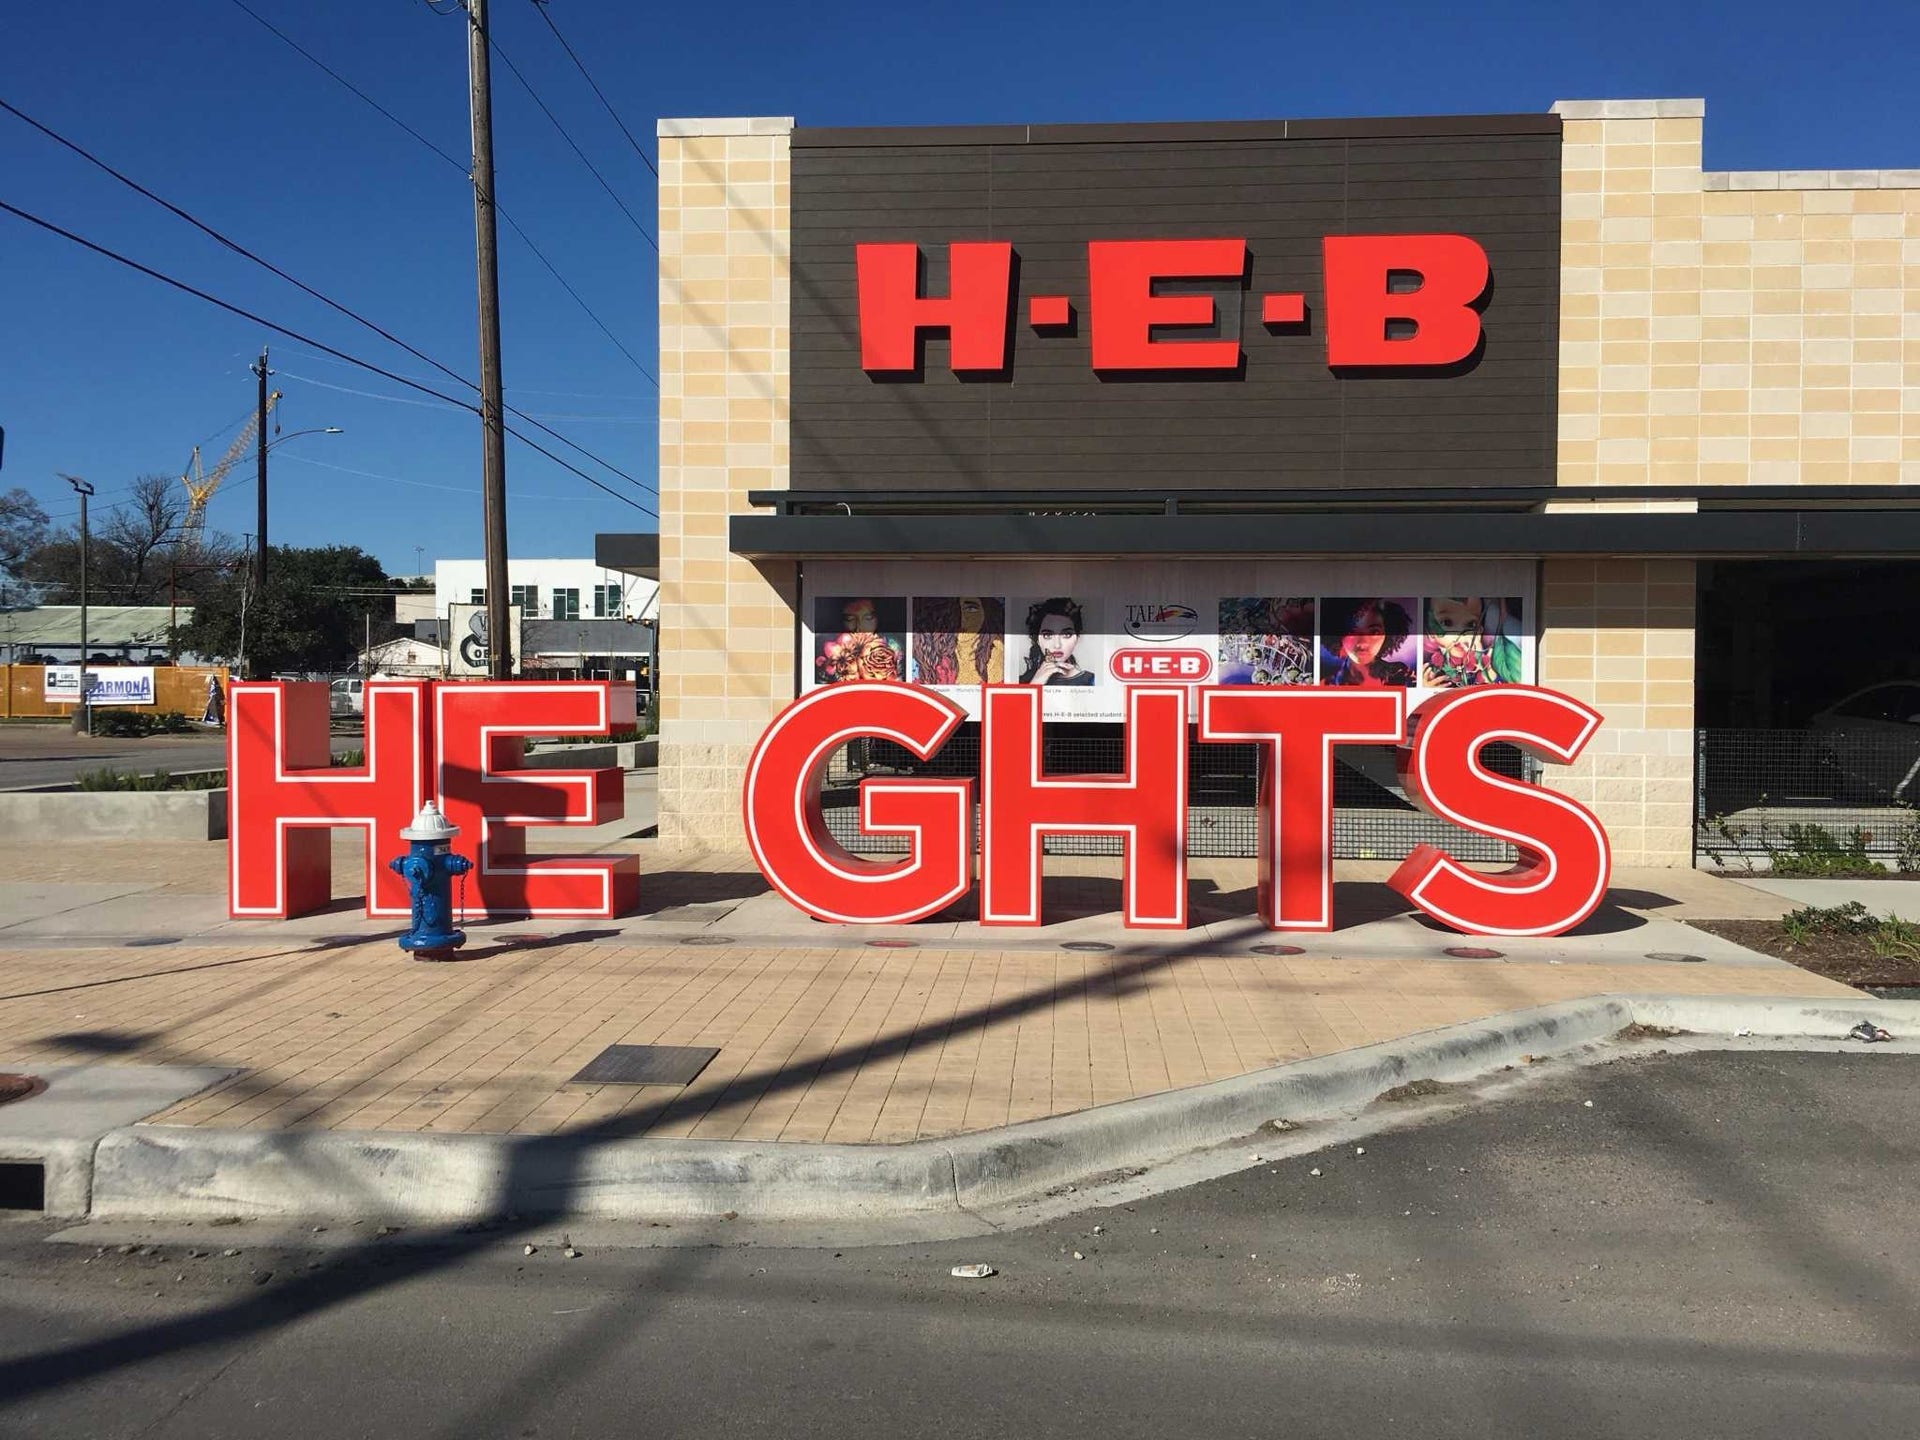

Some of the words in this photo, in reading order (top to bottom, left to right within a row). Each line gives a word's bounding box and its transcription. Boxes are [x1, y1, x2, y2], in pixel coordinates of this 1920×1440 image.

[855, 234, 1489, 371] H-E-B
[1122, 656, 1201, 674] H-E-B
[90, 676, 151, 695] ARMONA
